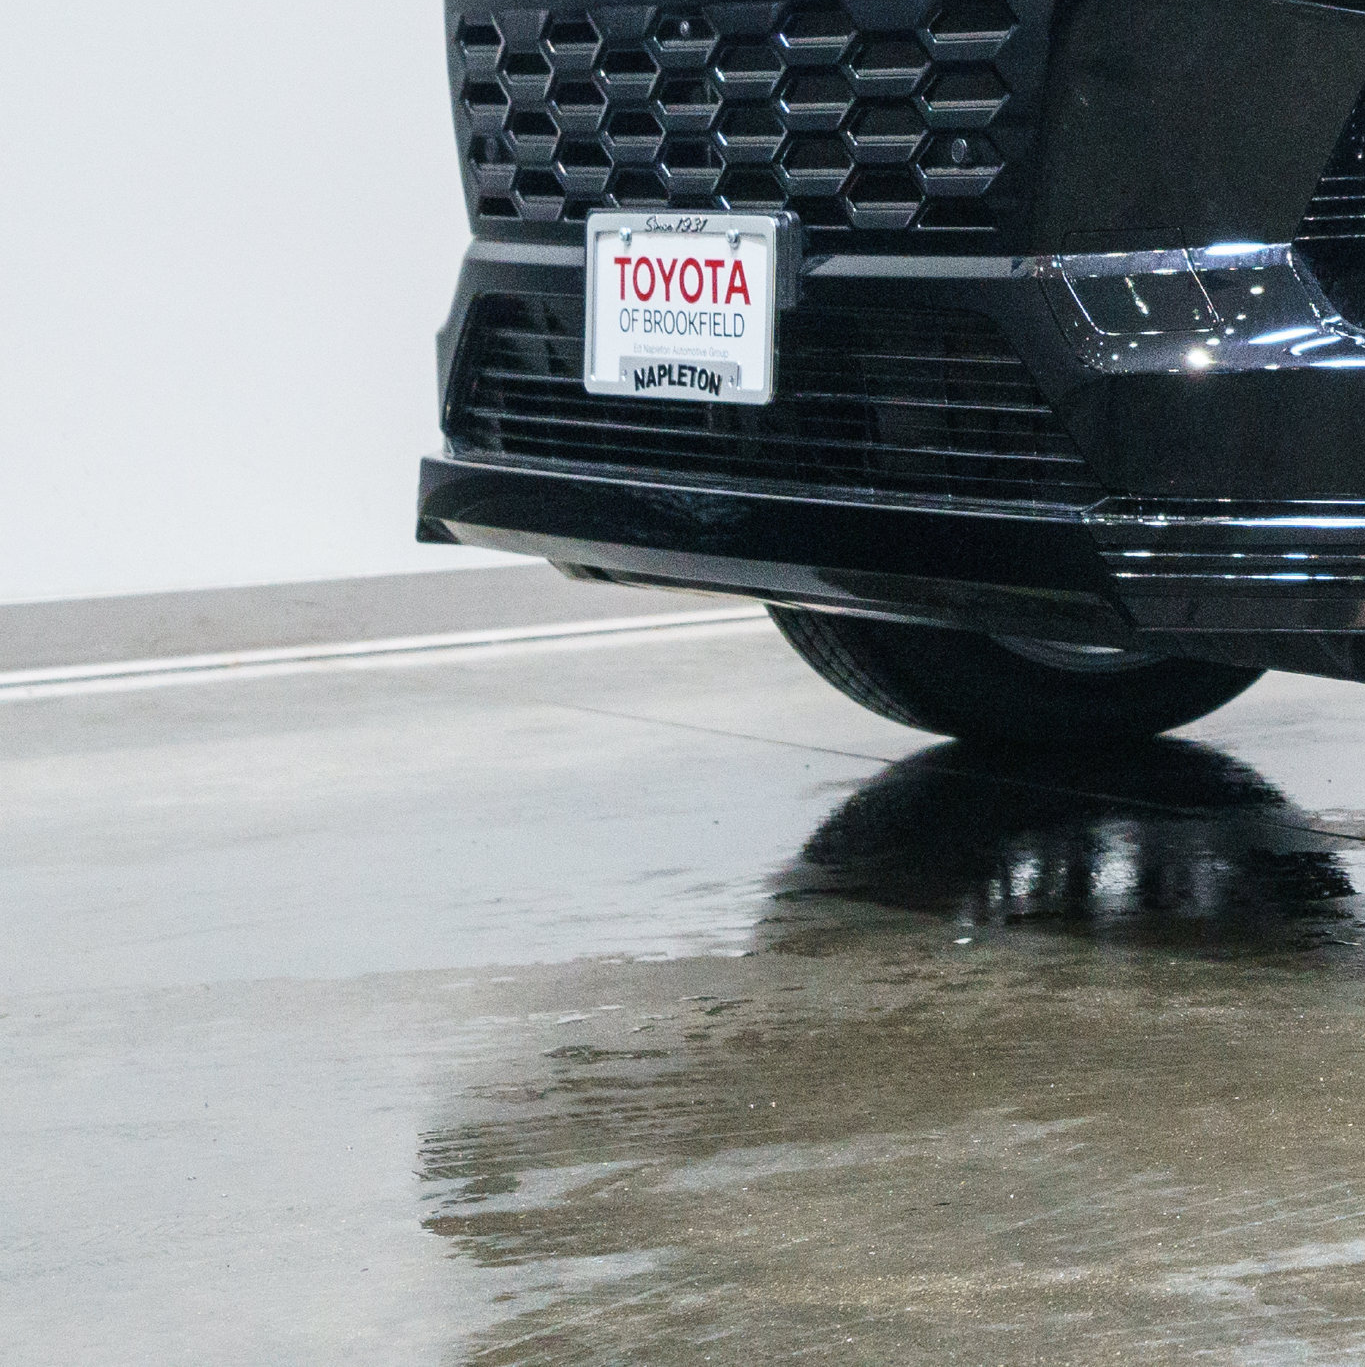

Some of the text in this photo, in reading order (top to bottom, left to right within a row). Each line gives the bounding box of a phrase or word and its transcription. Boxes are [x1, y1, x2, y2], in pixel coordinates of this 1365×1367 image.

[645, 215, 708, 233] Since 1931
[613, 256, 752, 306] TOYOTA
[619, 308, 745, 338] OF BROOKFIELD
[643, 344, 671, 355] Napleton
[672, 346, 707, 356] Automotive
[708, 347, 729, 359] Group
[633, 364, 722, 396] NAPLETON
